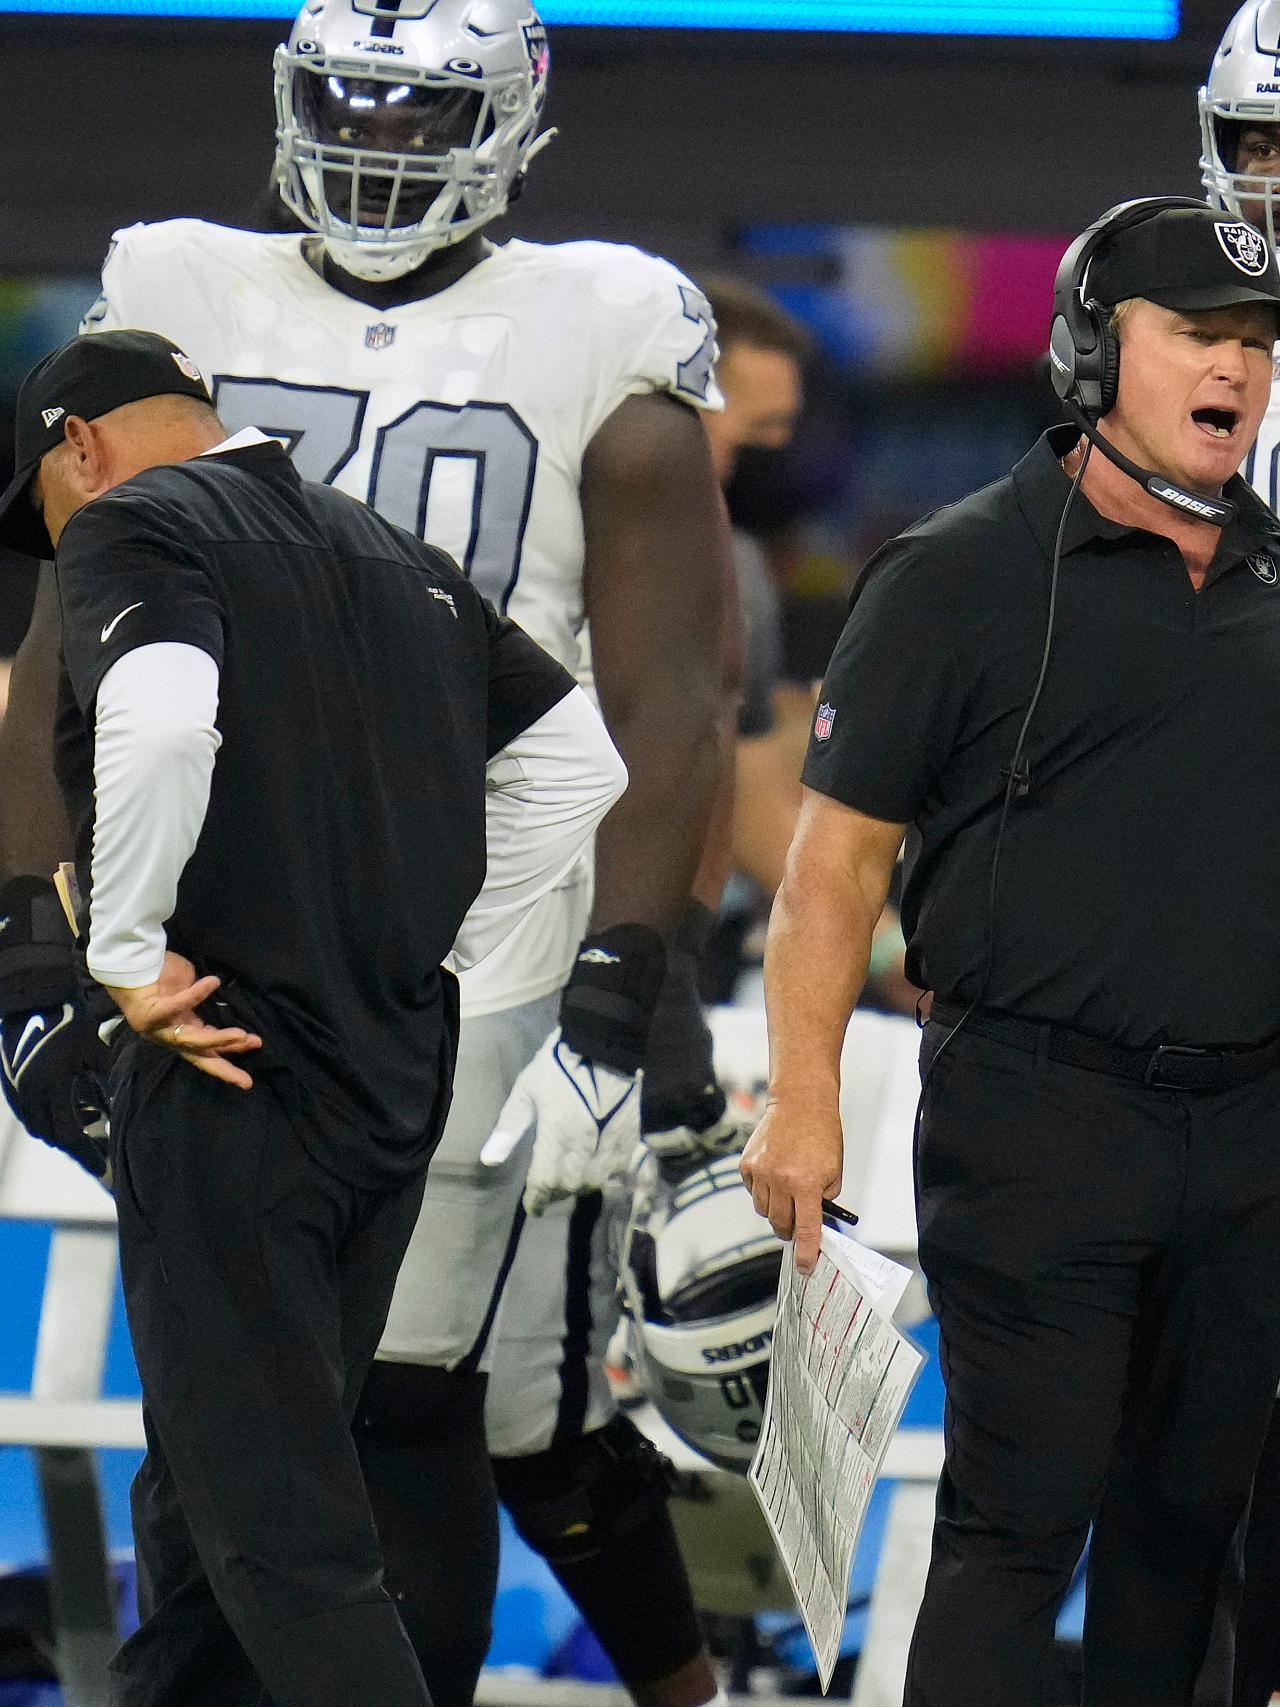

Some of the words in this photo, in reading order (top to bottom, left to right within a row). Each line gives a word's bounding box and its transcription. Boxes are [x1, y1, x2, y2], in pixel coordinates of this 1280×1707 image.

[353, 41, 404, 55] RIDERS
[1223, 227, 1263, 246] RAIDERS
[212, 374, 539, 618] 70
[1150, 487, 1226, 518] BOSE
[702, 1331, 773, 1363] IDERS
